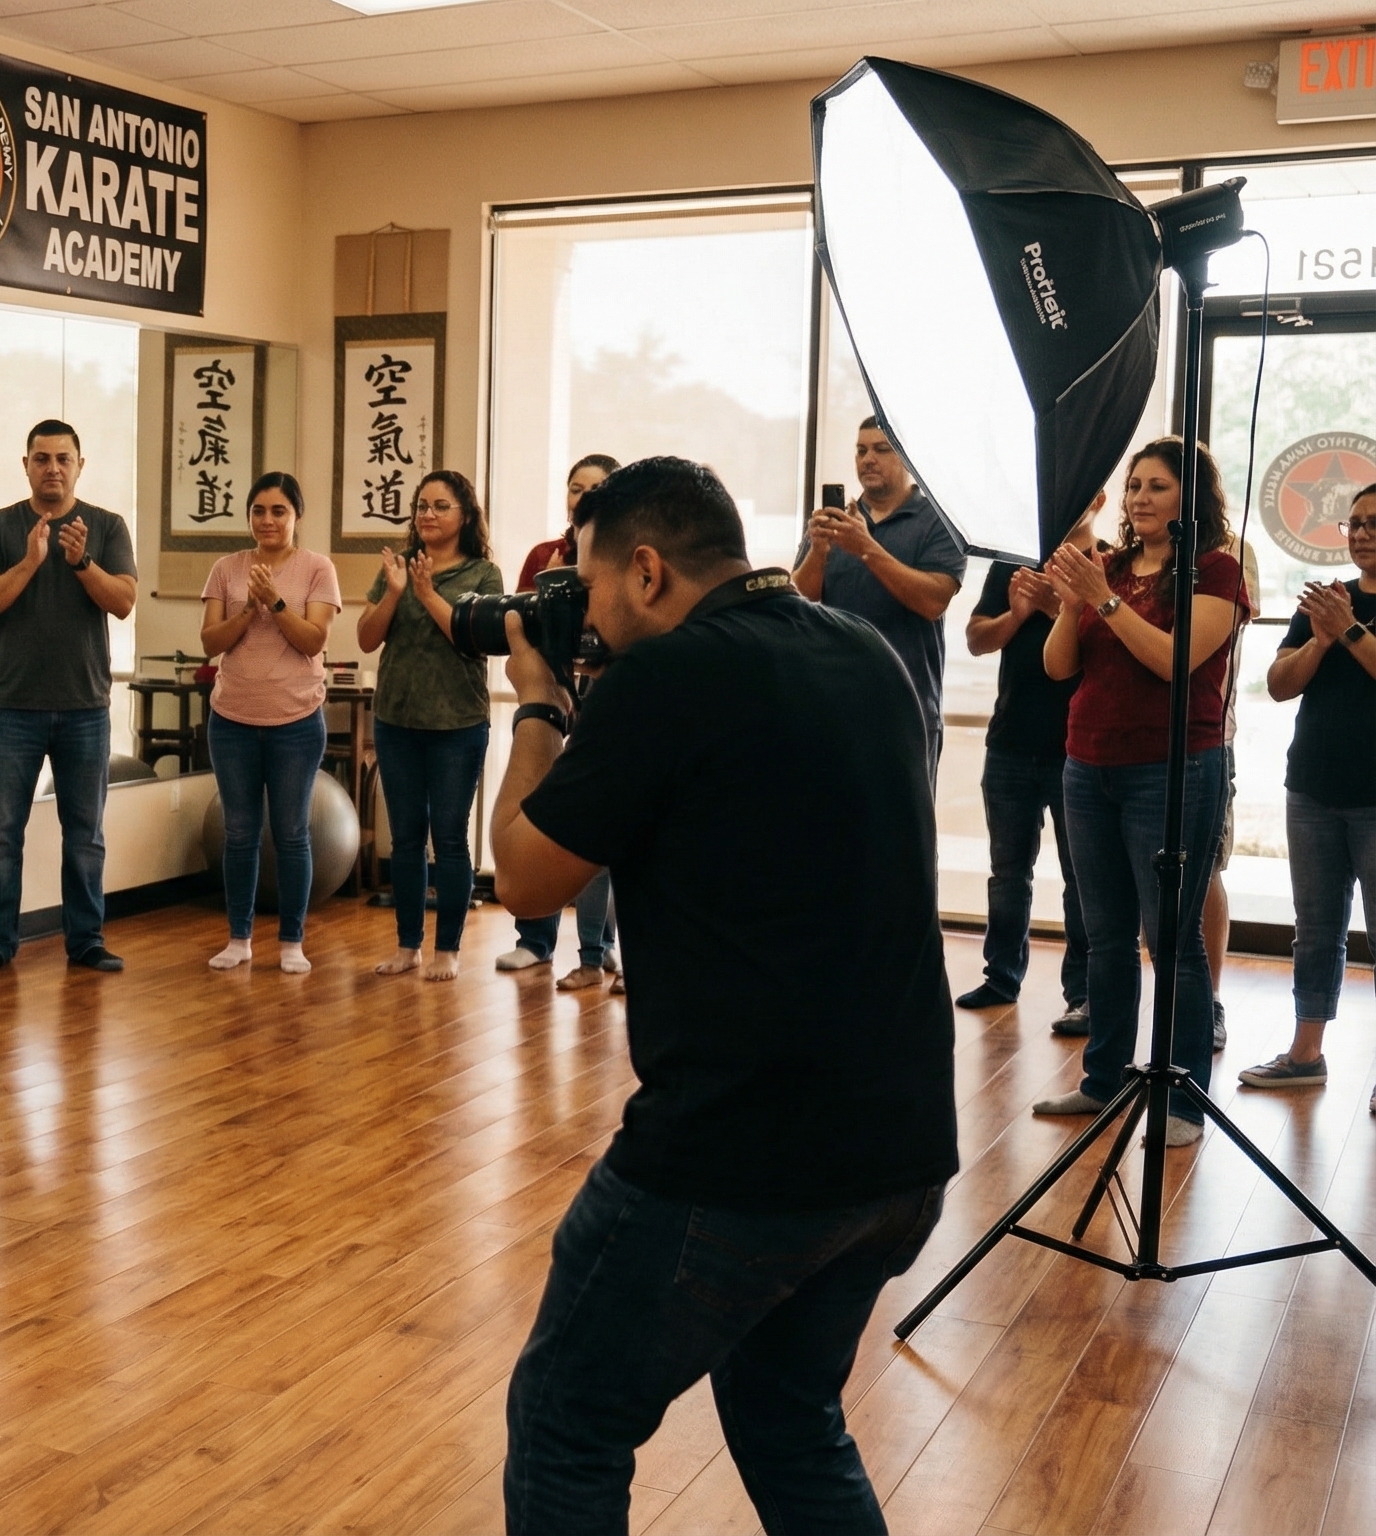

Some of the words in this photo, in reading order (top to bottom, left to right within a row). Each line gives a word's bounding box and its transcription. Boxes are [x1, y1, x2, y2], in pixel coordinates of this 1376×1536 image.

[24, 85, 81, 141] SAN
[87, 103, 200, 170] ANTONIO
[25, 140, 200, 244] KARATE
[43, 227, 182, 293] ACADEMY
